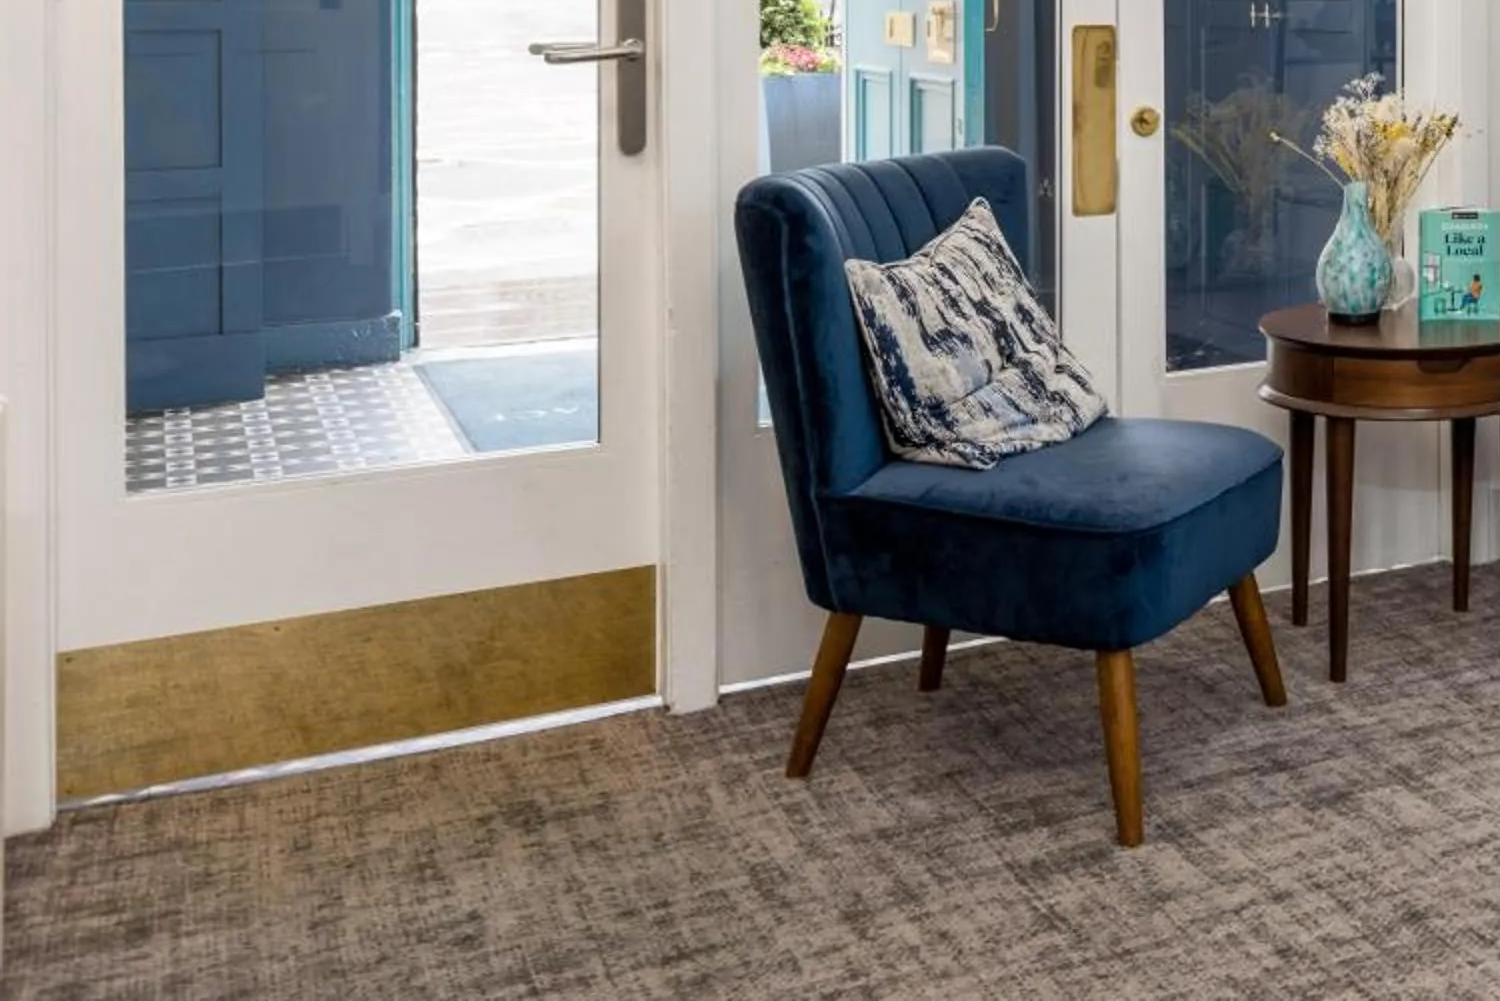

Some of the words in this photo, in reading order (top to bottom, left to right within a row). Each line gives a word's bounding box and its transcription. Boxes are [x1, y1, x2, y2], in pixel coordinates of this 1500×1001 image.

[1445, 232, 1473, 244] Like
[1477, 235, 1486, 244] a
[1446, 245, 1483, 256] Local
